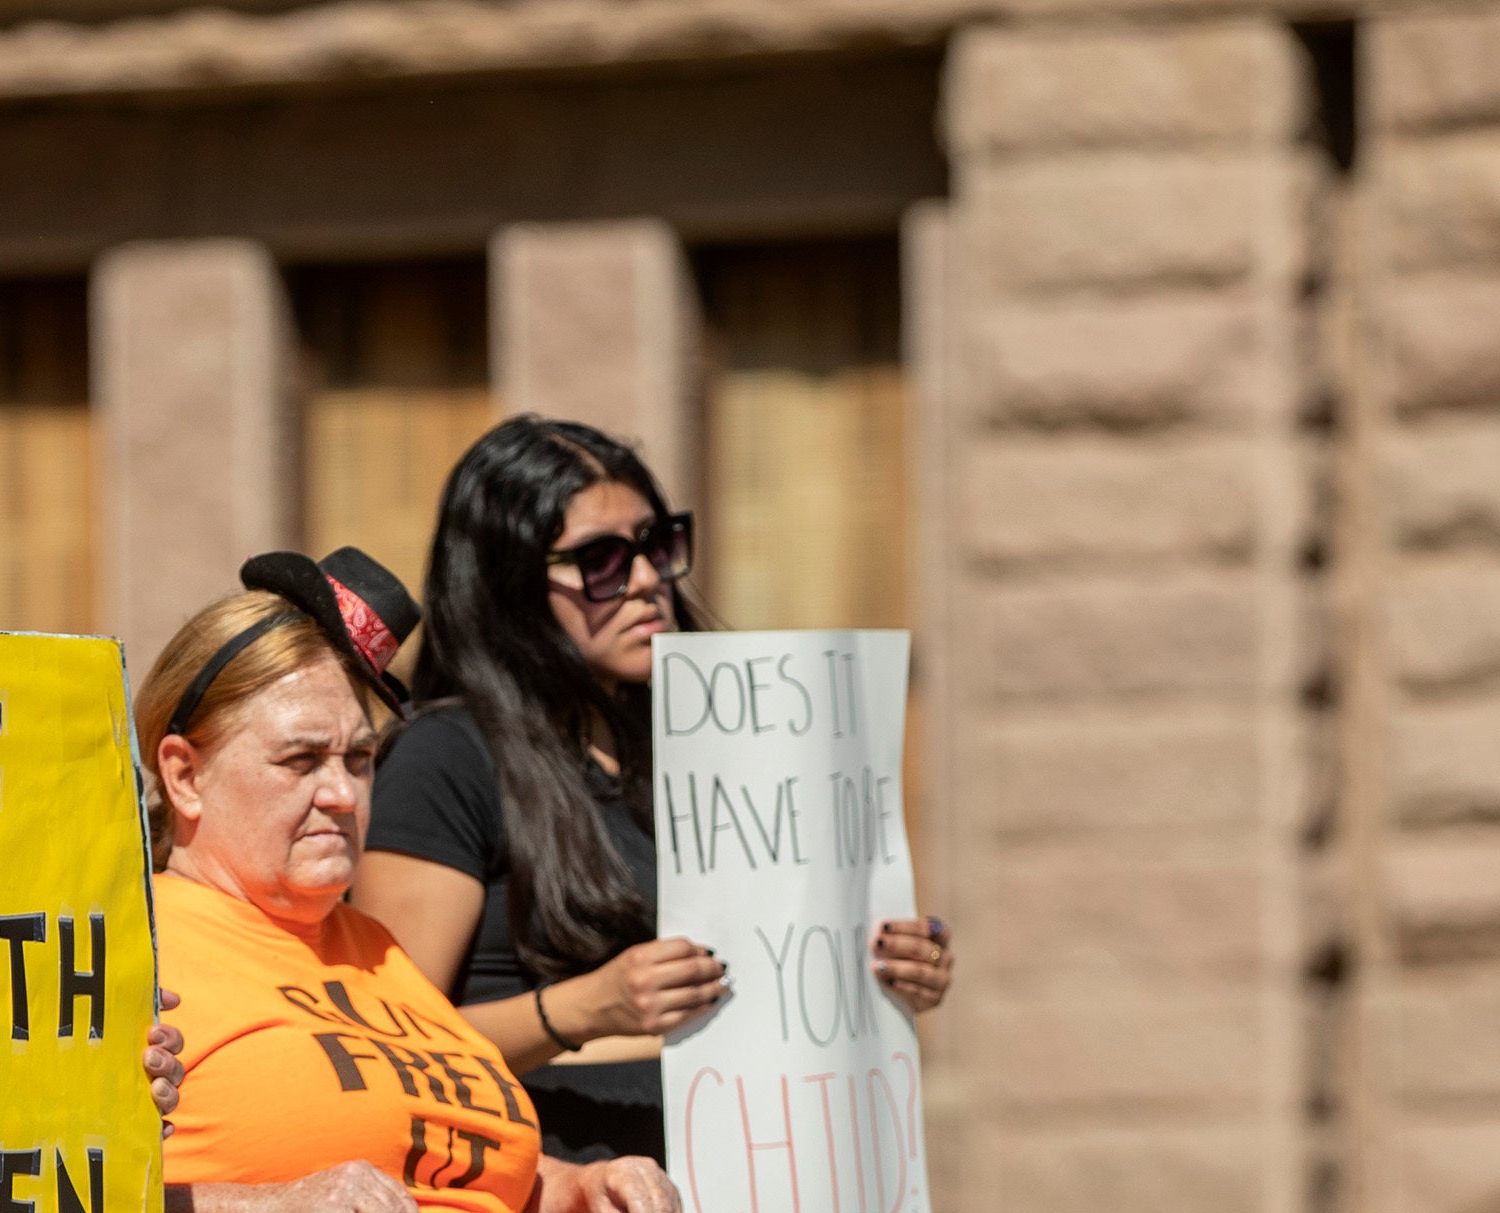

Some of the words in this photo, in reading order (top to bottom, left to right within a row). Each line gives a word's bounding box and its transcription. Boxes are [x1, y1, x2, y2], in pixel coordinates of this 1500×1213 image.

[662, 652, 812, 738] DOES
[663, 771, 810, 875] HAVE
[312, 1032, 536, 1130] FREE
